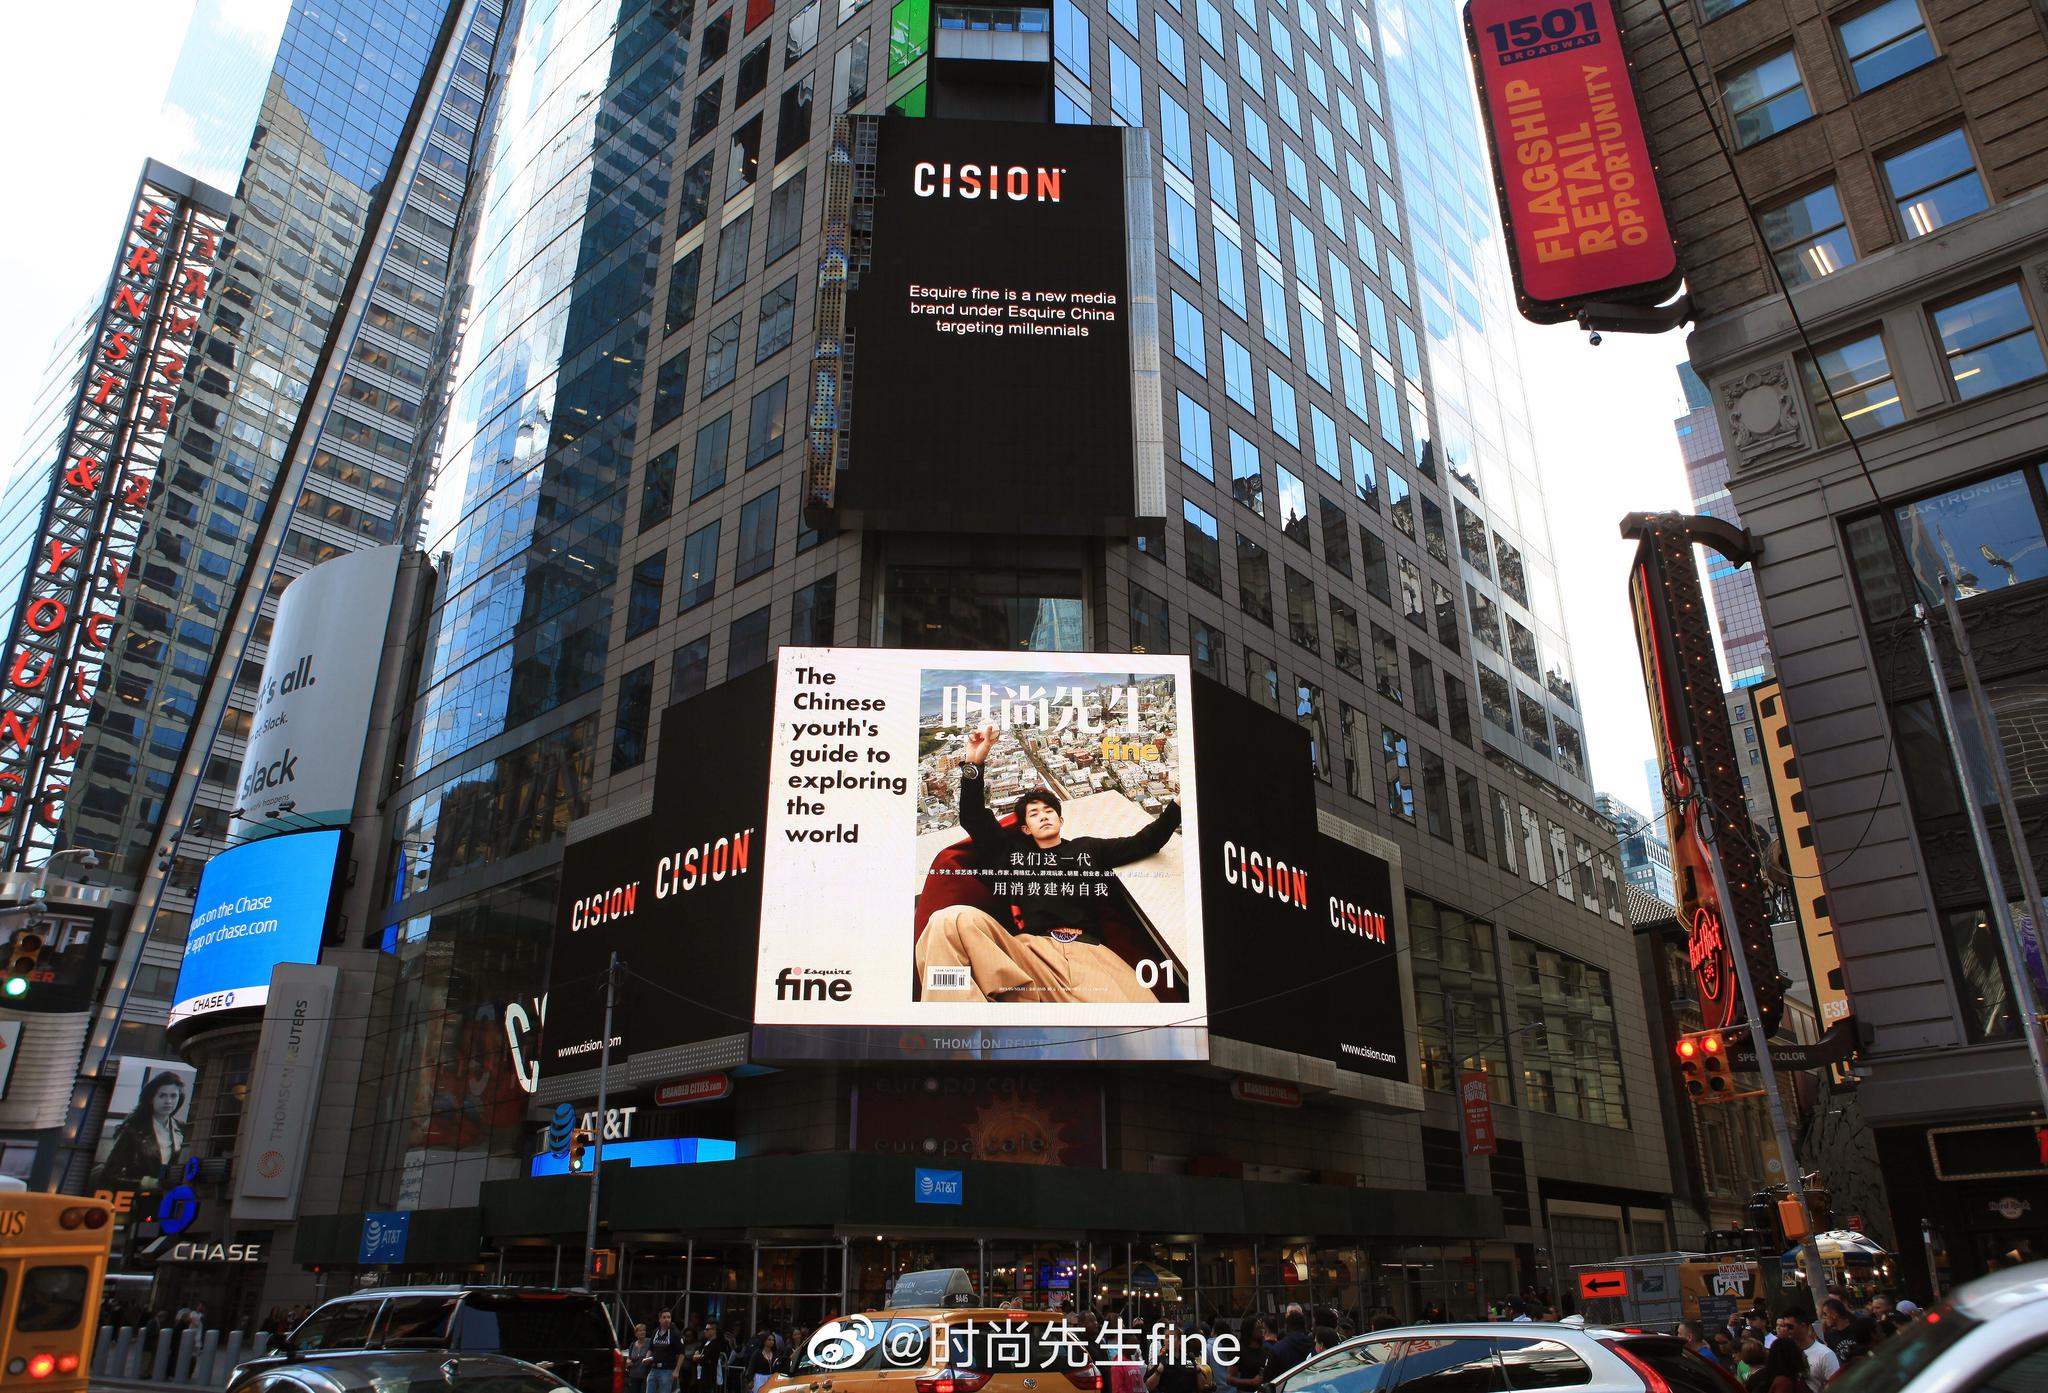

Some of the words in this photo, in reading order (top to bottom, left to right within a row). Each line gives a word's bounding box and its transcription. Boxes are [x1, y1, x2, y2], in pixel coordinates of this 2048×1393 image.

[1486, 2, 1598, 52] 1501
[1502, 34, 1597, 63] BROADWAY
[1582, 65, 1648, 246] OPPORTUNITY
[913, 162, 1062, 202] CISION
[1504, 79, 1575, 263] FLAGSHIP
[1556, 121, 1617, 255] RETAIL
[93, 205, 168, 405] ERNST
[909, 285, 967, 301] Esquire
[971, 287, 1000, 300] fine
[1004, 288, 1017, 300] is
[1021, 291, 1031, 301] a
[1035, 291, 1067, 302] new
[1071, 292, 1117, 304] media
[910, 302, 955, 315] brand
[959, 304, 1003, 317] under
[1008, 305, 1066, 320] Esquire
[1070, 308, 1115, 321] China
[936, 320, 1004, 336] targeting
[1008, 323, 1089, 337] millennials
[66, 457, 101, 491] &
[1900, 477, 2024, 521] DAKTRONICS
[280, 654, 316, 697] all.
[795, 667, 836, 685] The
[793, 692, 886, 712] Chinese
[942, 684, 1157, 735] 时尚先生
[263, 711, 288, 734] Slack.
[791, 717, 879, 741] youth's
[790, 743, 858, 767] guide
[866, 747, 891, 763] to
[1100, 735, 1161, 762] fine
[241, 748, 298, 800] slack
[788, 769, 907, 796] exploring
[786, 796, 825, 815] the
[785, 823, 859, 843] world
[655, 829, 750, 899] CISION
[1010, 851, 1093, 867] 我们这一代
[1223, 840, 1308, 910] CISION
[993, 882, 1109, 898] 用消费建构自我
[206, 908, 217, 923] on
[217, 901, 234, 919] the
[234, 895, 273, 915] Chase
[571, 881, 638, 932] CISION
[205, 931, 216, 945] or
[216, 919, 278, 942] chase.com
[1328, 896, 1386, 944] CISION
[775, 967, 853, 1002] fine
[803, 968, 852, 976] Esquire
[1135, 959, 1175, 990] 01
[192, 994, 224, 1013] CHASE
[558, 1035, 622, 1058] www.cision.om
[1340, 1042, 1397, 1064] www.cision.com
[662, 1084, 690, 1099] BRANDED
[579, 1107, 637, 1142] AT&T
[935, 1181, 958, 1194] AT&T
[381, 1229, 402, 1244] AT&T
[173, 1242, 261, 1262] CHASE
[1720, 1263, 1747, 1273] NATIONAL
[1712, 1275, 1745, 1297] CAT
